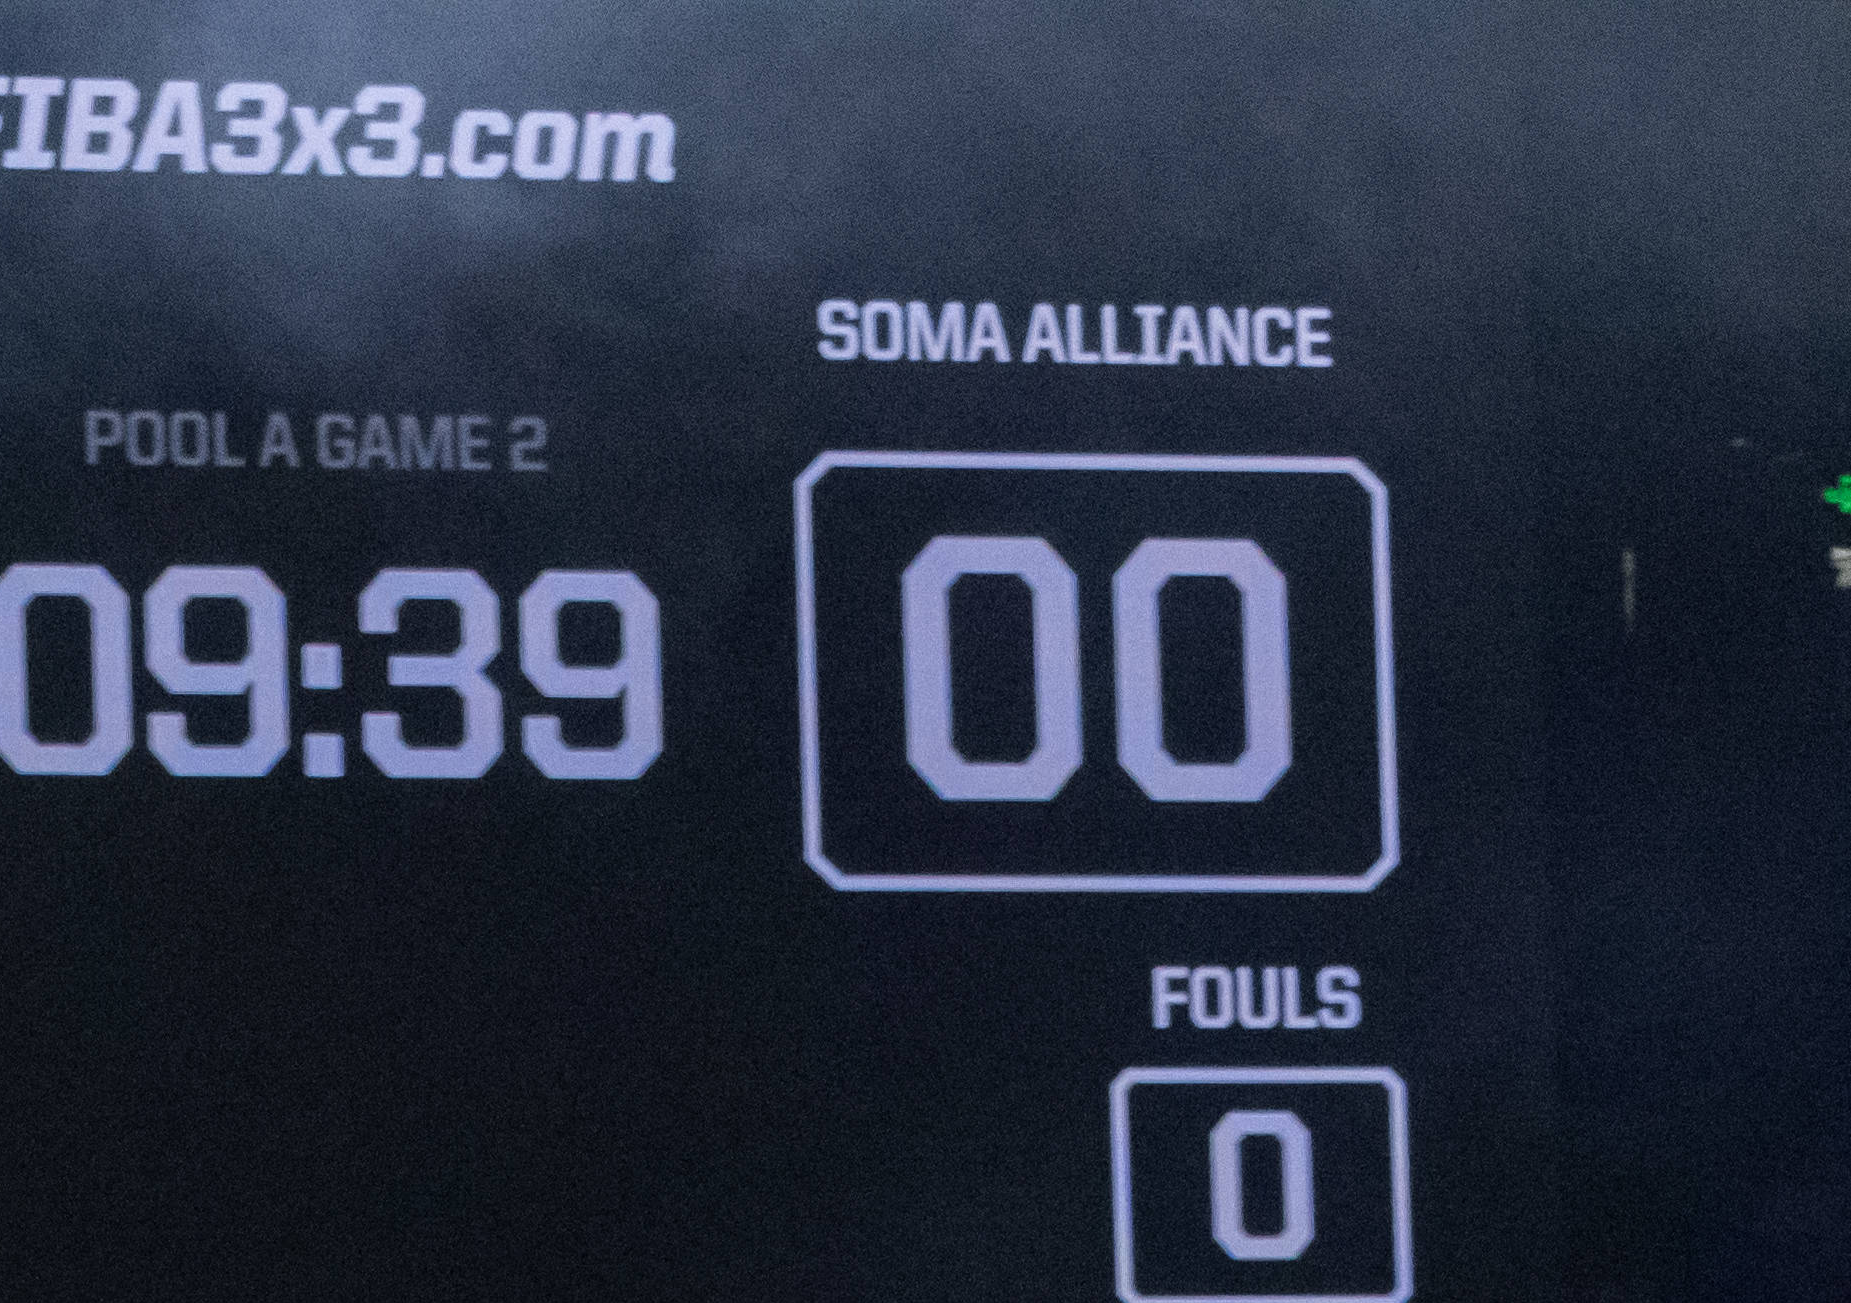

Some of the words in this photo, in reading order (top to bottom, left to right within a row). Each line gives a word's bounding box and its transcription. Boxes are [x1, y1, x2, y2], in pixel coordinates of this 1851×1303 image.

[816, 299, 1011, 364] SOMA
[1021, 302, 1334, 368] ALLIANCE
[83, 409, 247, 468] POOL
[258, 411, 299, 468] A
[314, 412, 492, 471] GAME
[509, 416, 549, 472] 2
[900, 534, 1294, 801] 00
[1151, 965, 1364, 1030] FOULS
[1209, 1109, 1316, 1262] 0
